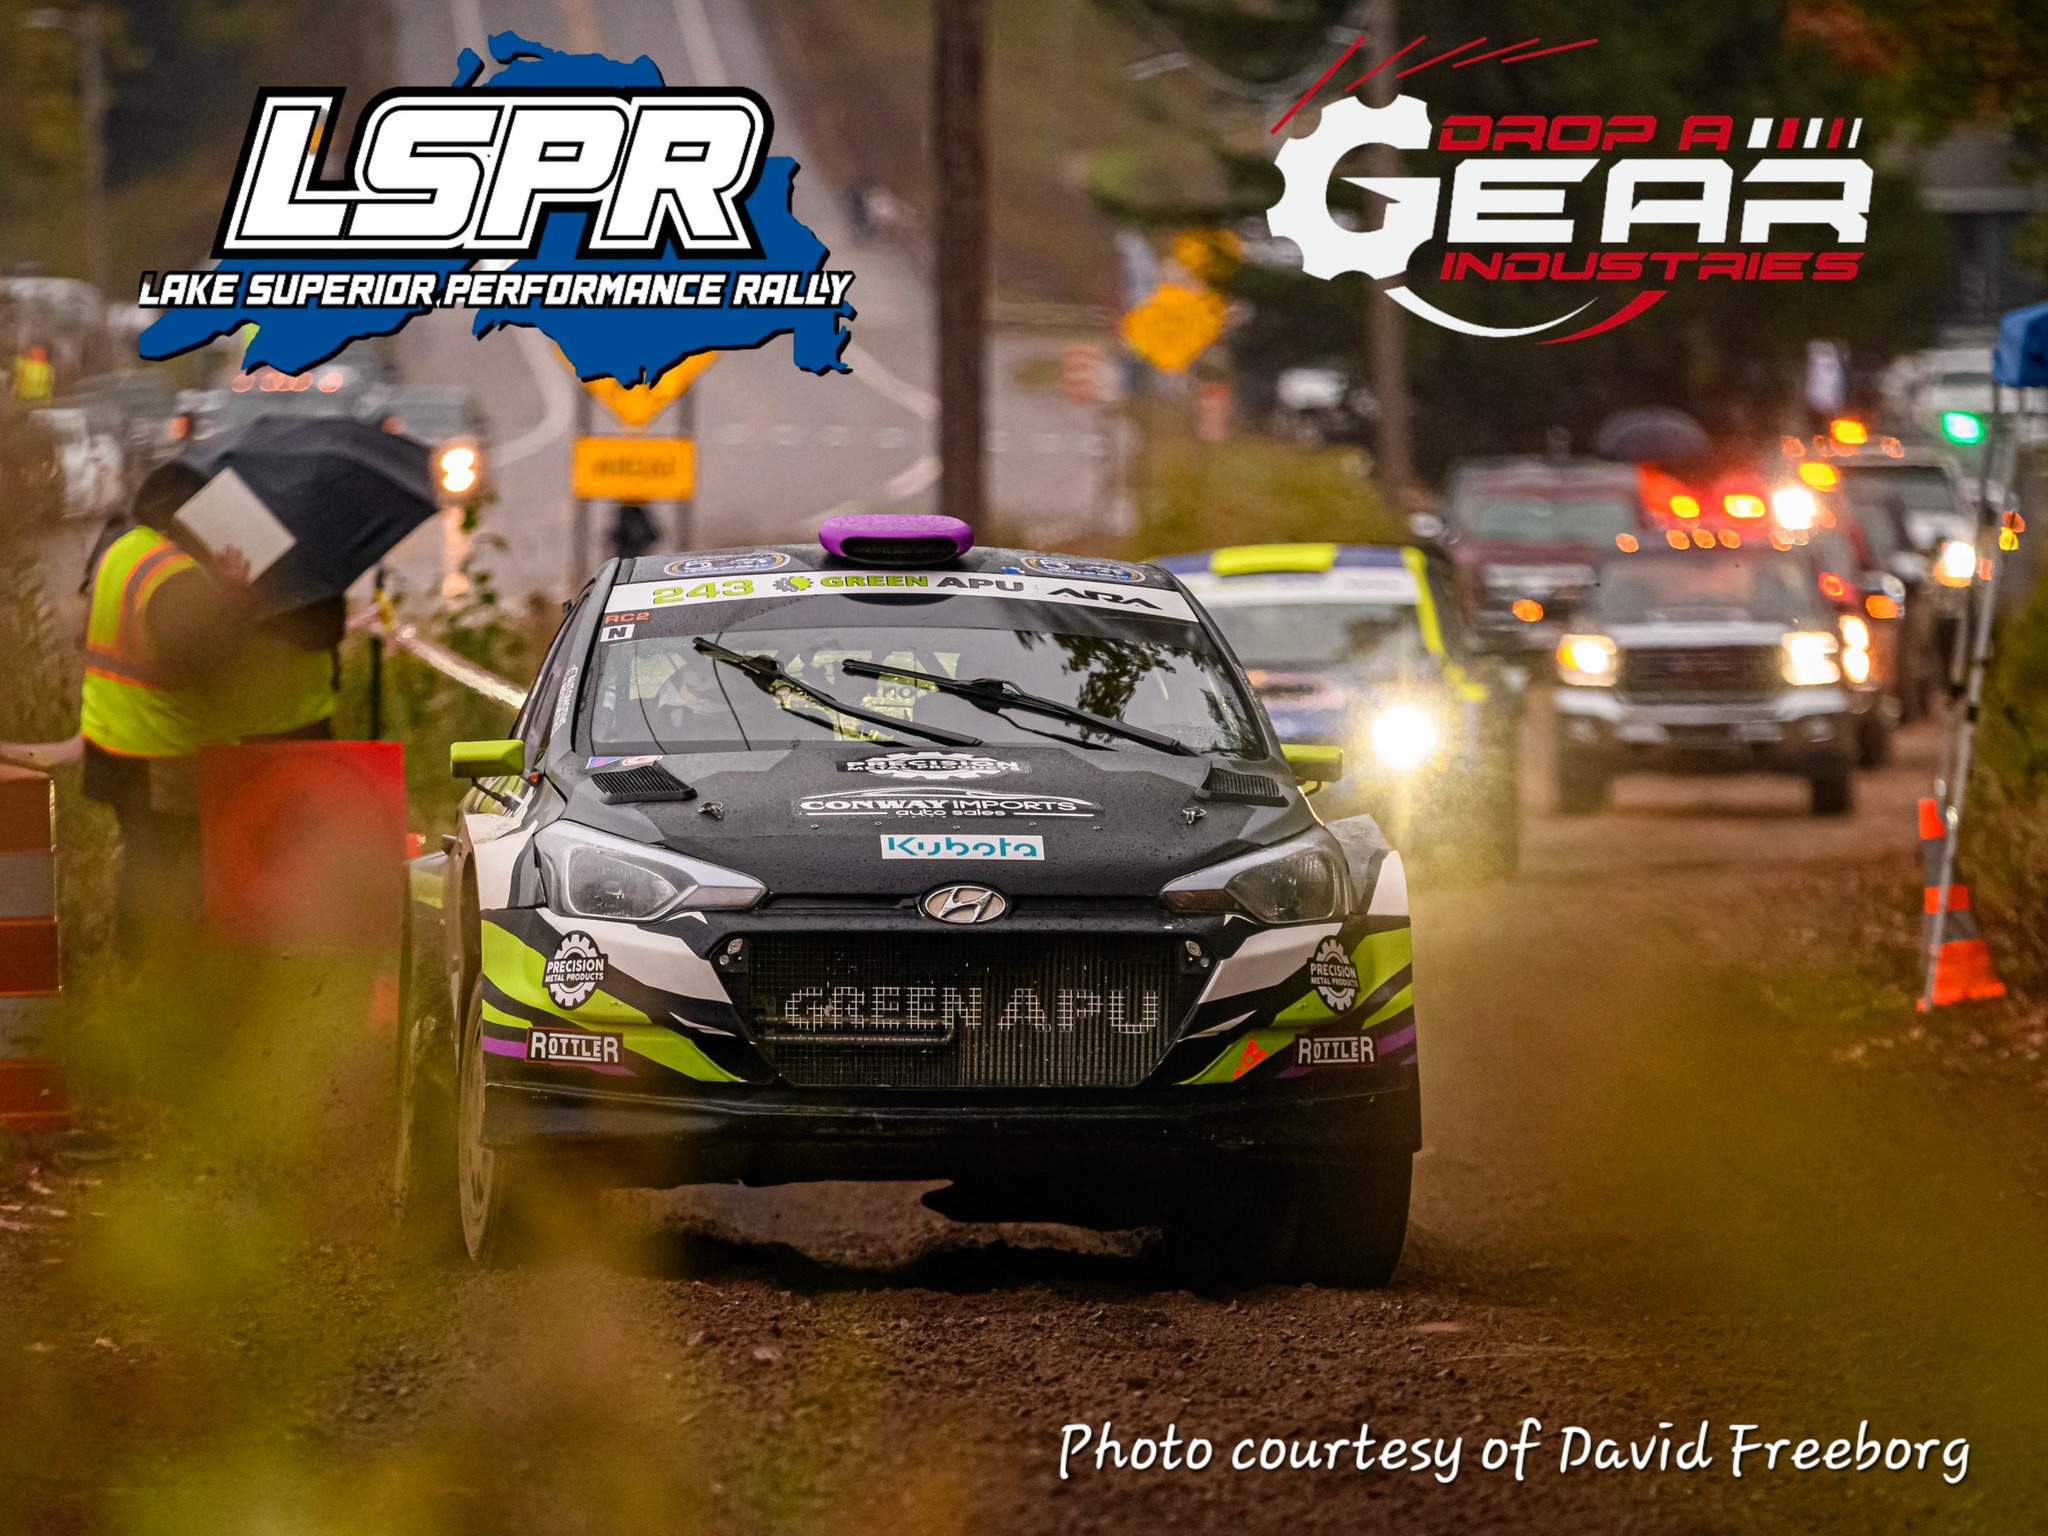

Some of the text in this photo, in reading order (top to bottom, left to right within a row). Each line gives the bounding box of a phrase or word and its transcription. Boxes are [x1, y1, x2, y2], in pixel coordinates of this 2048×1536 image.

[652, 574, 1164, 610] 243 GREEN APU ARA
[604, 611, 650, 624] RC2
[607, 625, 628, 639] N
[846, 760, 1020, 769] PRECISION
[800, 799, 1077, 811] CONWAY IMPORTS
[895, 808, 1006, 817] auto sales
[887, 836, 1038, 858] Kubota
[546, 958, 605, 974] PRECISION
[1310, 962, 1357, 979] PRECISION
[544, 972, 604, 983] METAL PRODUCTS
[1310, 976, 1359, 988] METAL PRODUCTS
[785, 986, 1159, 1034] GREEN APU
[530, 1031, 619, 1063] ROTTLER
[1298, 1035, 1375, 1064] ROTTLER
